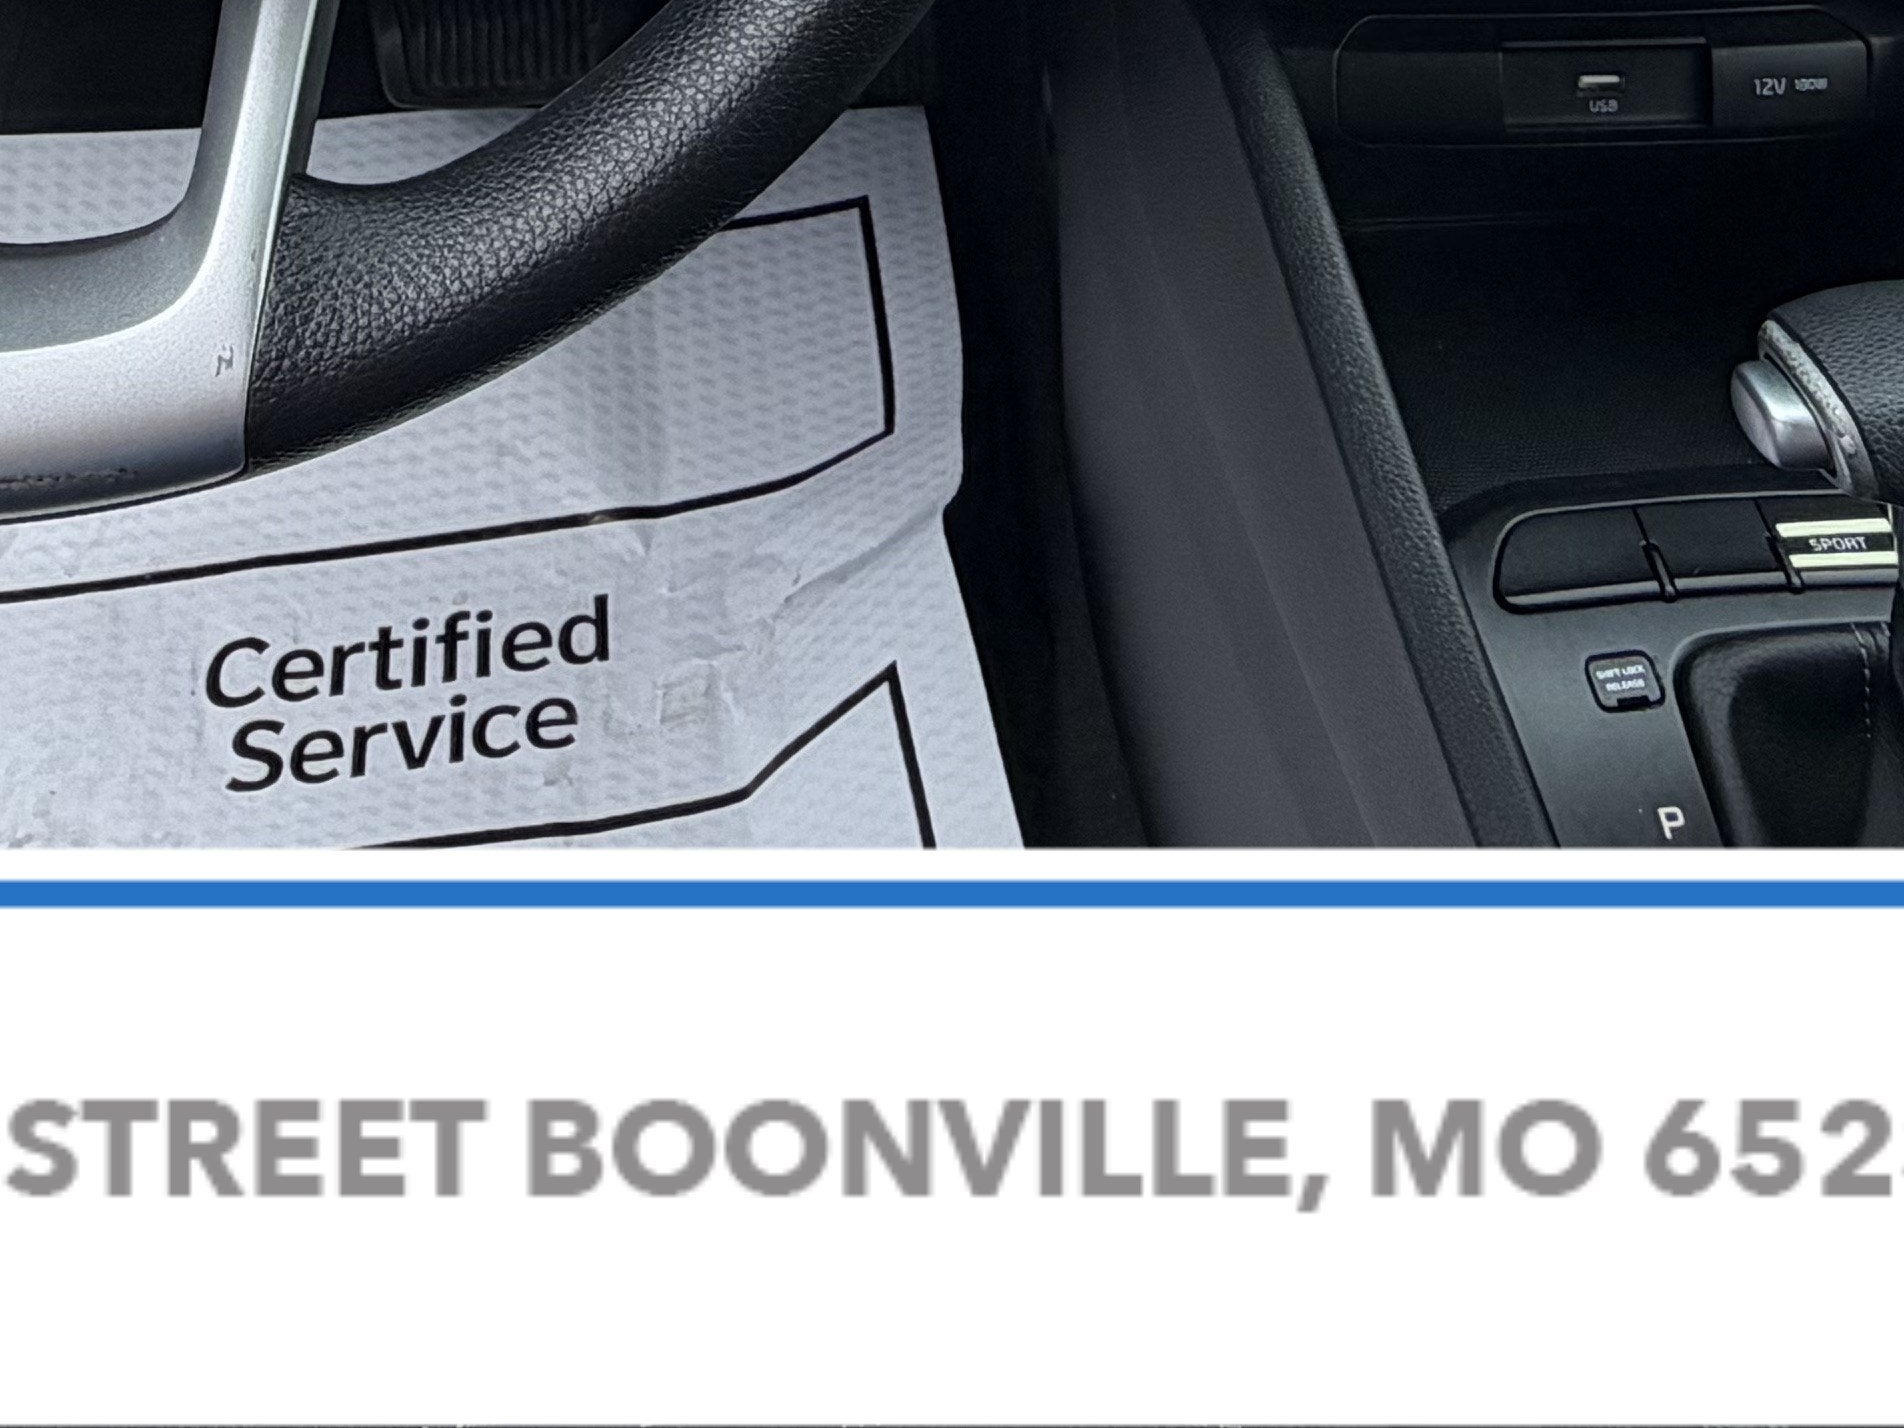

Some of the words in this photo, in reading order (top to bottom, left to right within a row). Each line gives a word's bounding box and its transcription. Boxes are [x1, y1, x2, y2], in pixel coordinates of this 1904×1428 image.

[1754, 76, 1788, 95] 12V
[1589, 98, 1619, 113] USB
[1808, 535, 1869, 553] SPORT
[203, 593, 611, 709] Certified
[224, 693, 580, 794] Service
[1657, 805, 1686, 841] P
